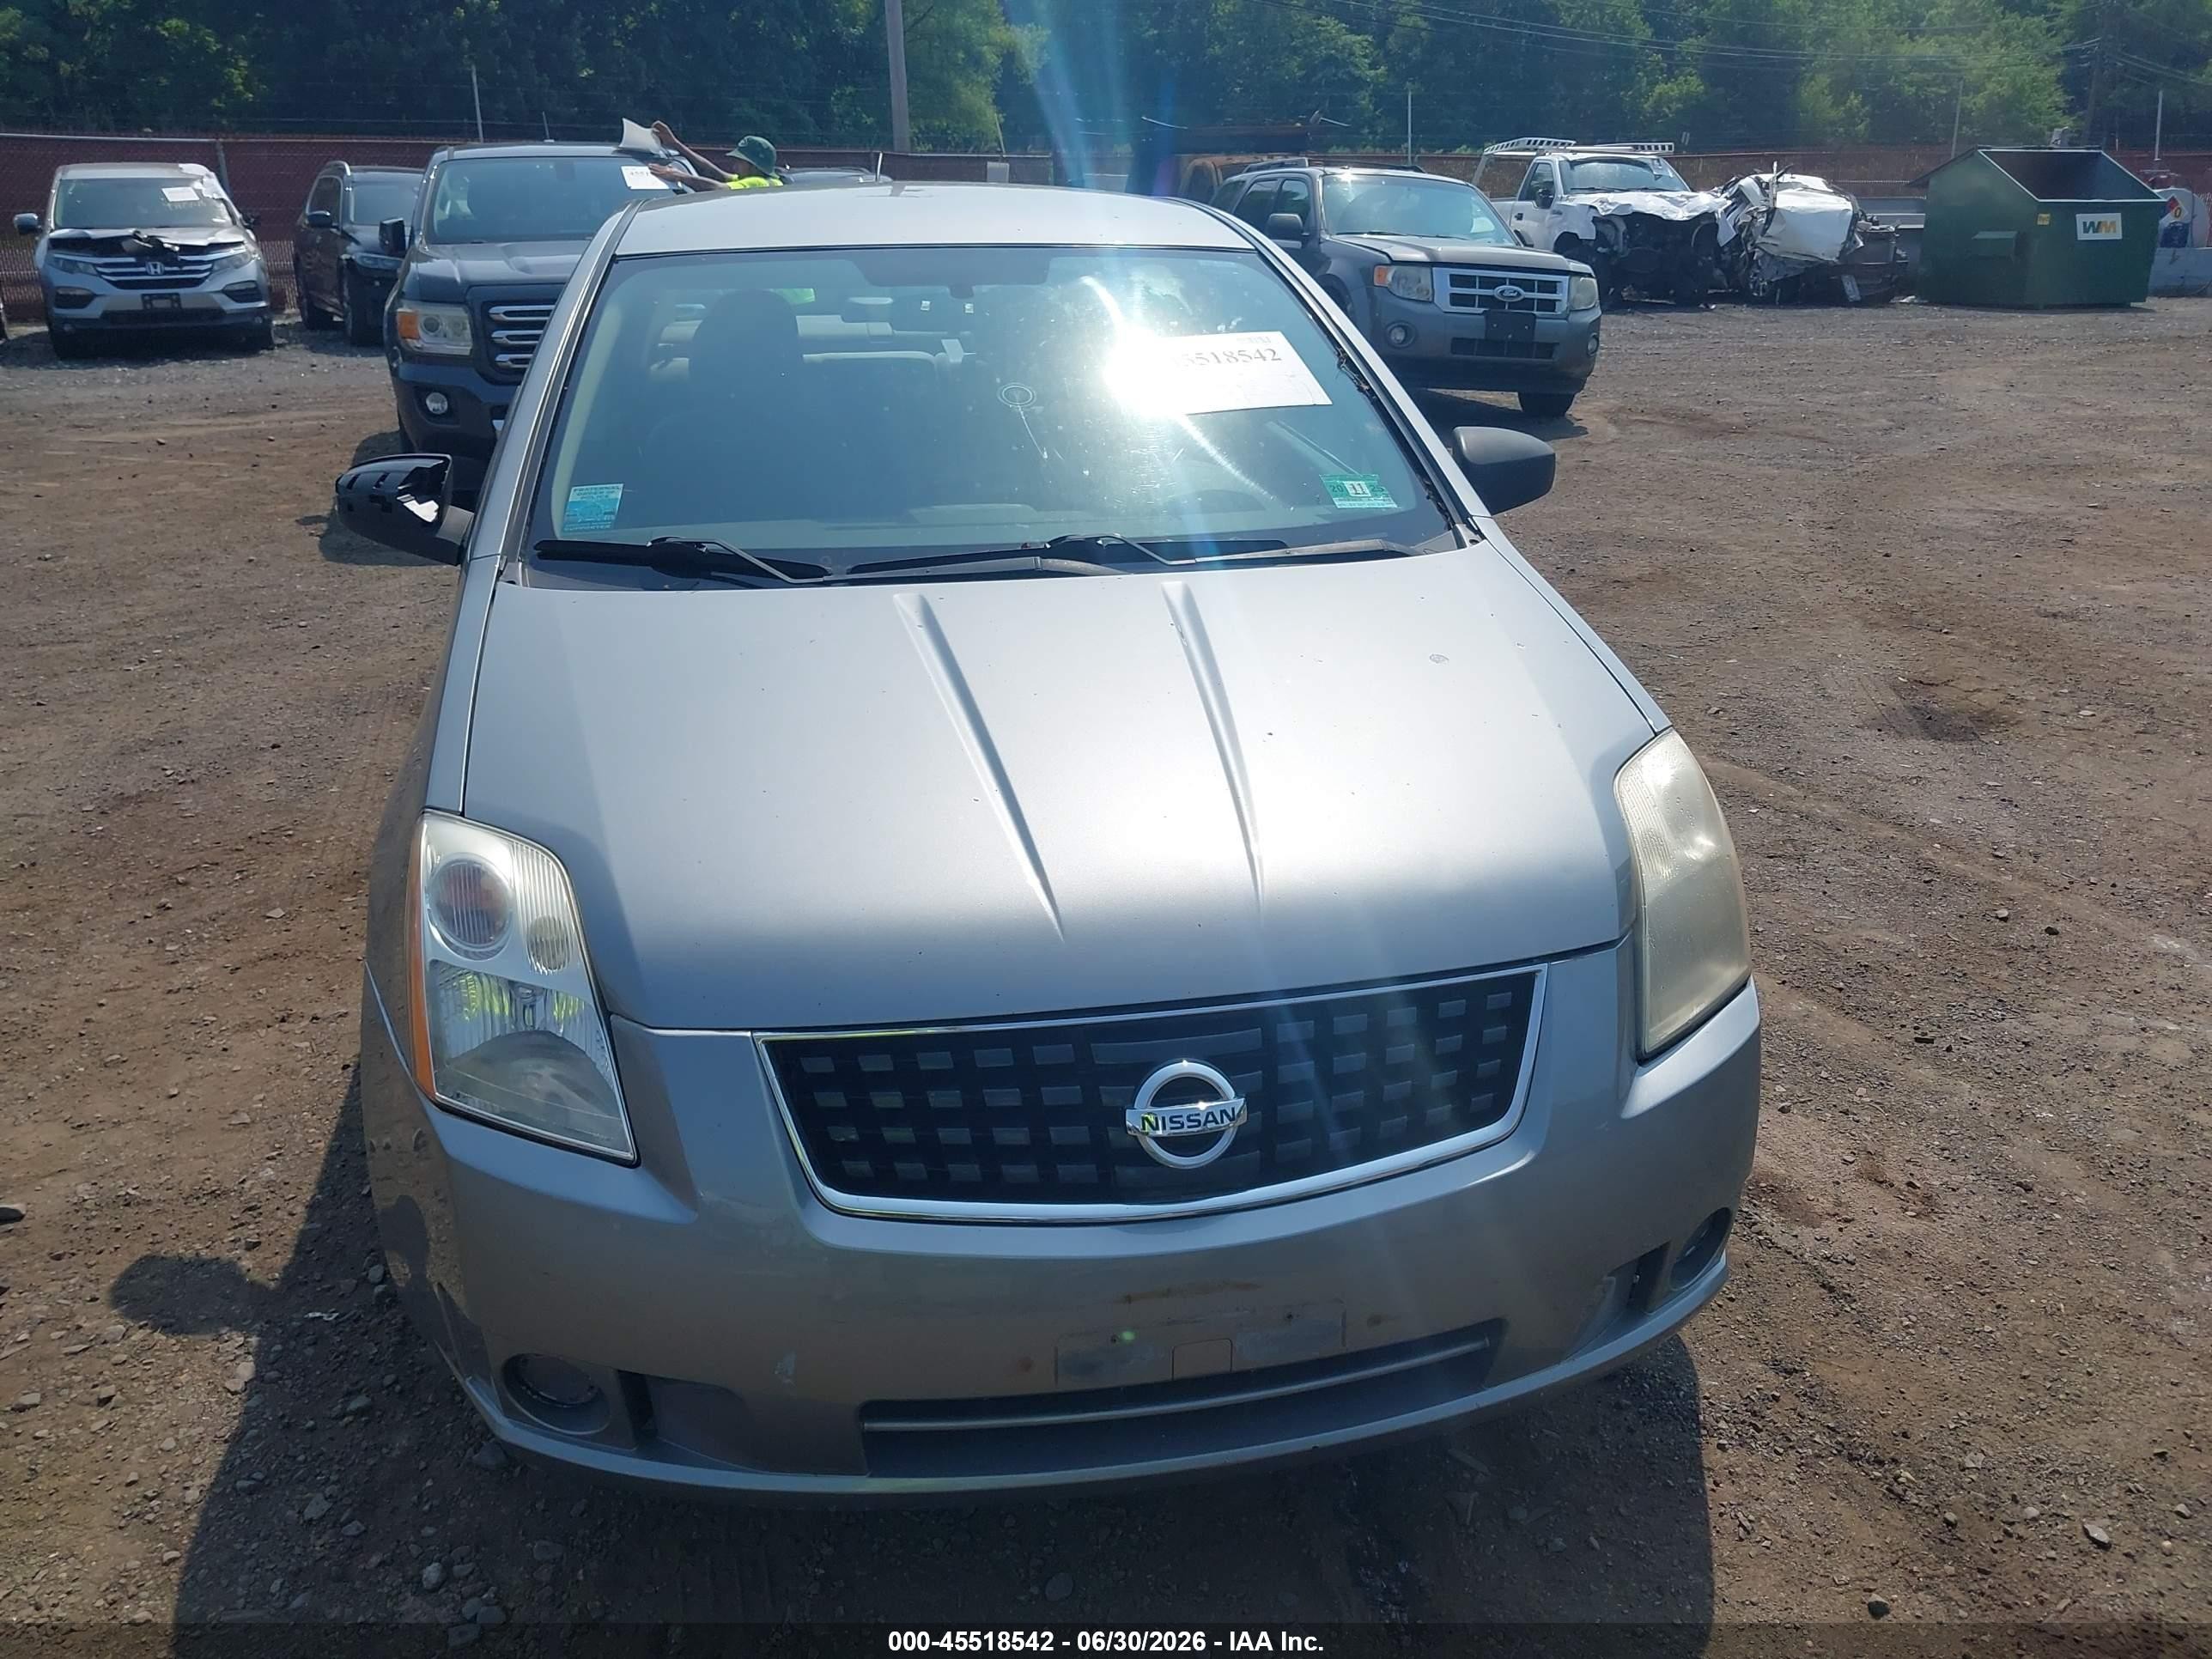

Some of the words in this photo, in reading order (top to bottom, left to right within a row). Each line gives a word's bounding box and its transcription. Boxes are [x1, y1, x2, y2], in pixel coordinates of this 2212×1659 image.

[2082, 221, 2117, 234] WM
[1170, 347, 1283, 367] 5518542
[1349, 483, 1369, 495] 11
[1139, 1106, 1236, 1132] NISSAN
